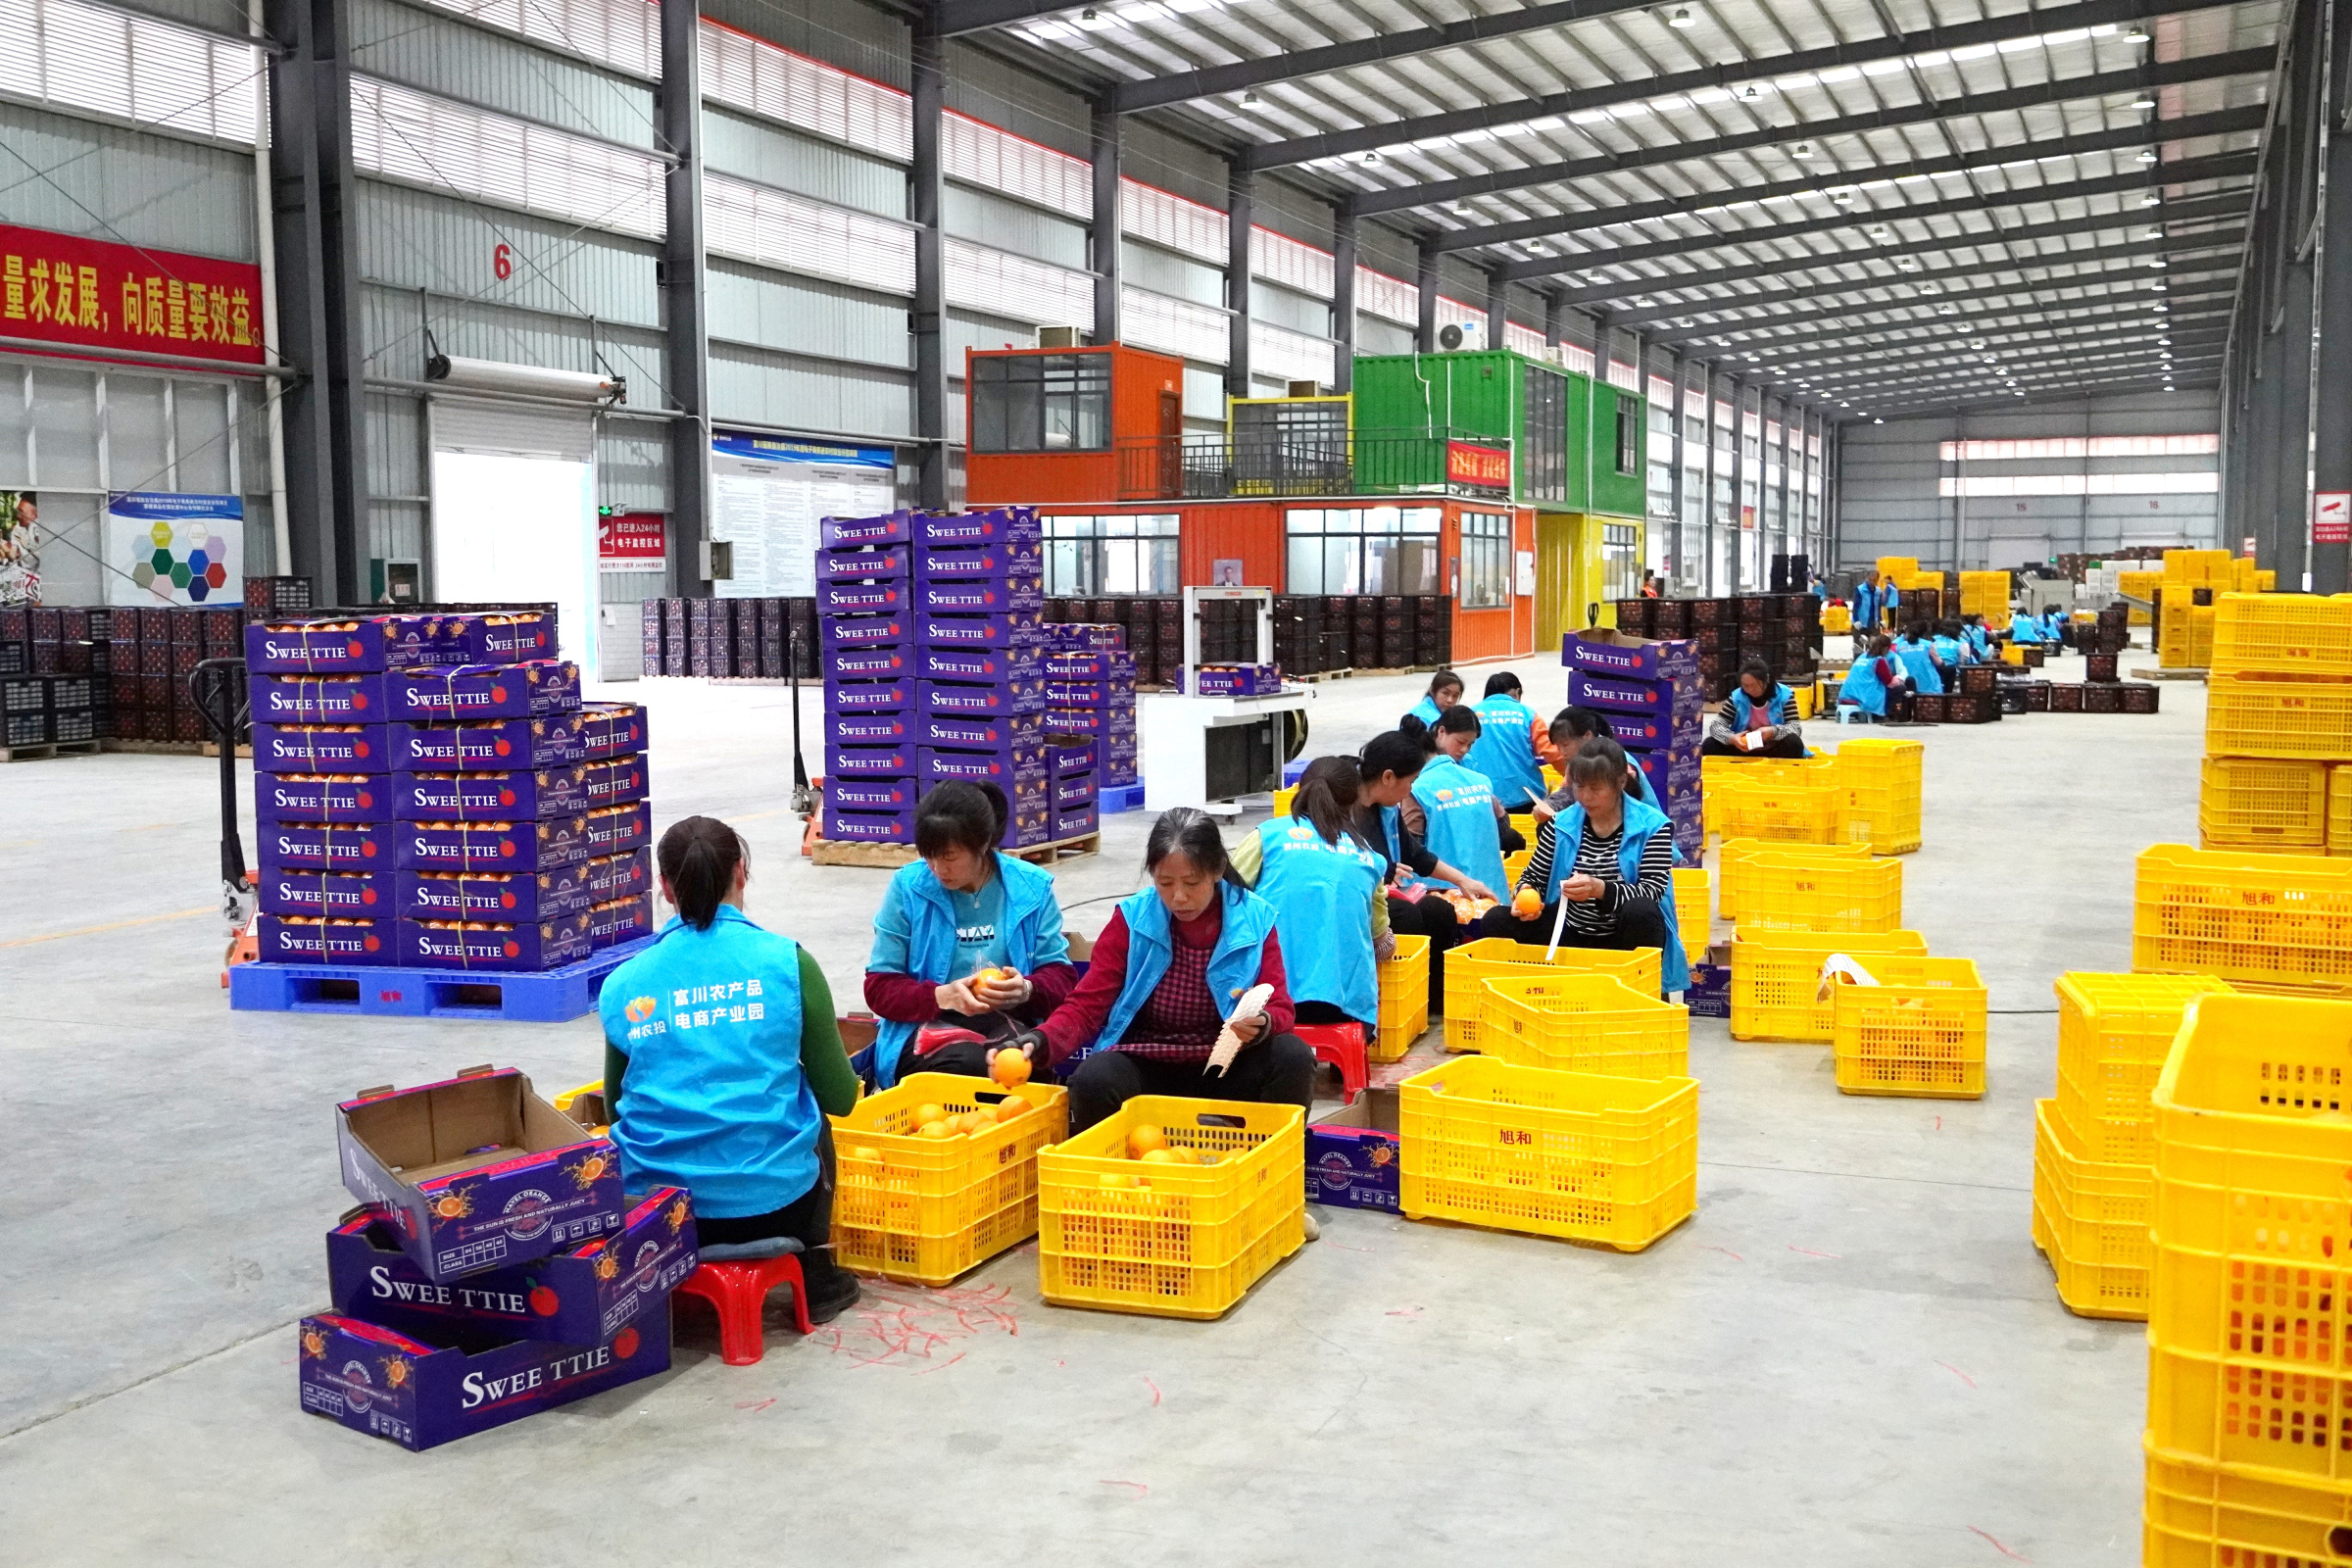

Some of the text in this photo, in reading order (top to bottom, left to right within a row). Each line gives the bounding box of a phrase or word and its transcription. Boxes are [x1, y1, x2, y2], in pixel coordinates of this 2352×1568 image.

[494, 244, 511, 281] 6
[616, 523, 661, 533] 您已进入24小时
[617, 538, 661, 548] 电子监控区域
[1796, 882, 1815, 891] 旭和
[2242, 892, 2275, 905] 旭和
[673, 979, 762, 1006] 富川农产品
[675, 1004, 764, 1029] 电商产业园
[1499, 1129, 1532, 1145] 旭和
[505, 1191, 552, 1213] NAVEL ORANGE
[506, 1215, 522, 1224] FRESH
[536, 1203, 568, 1215] NATURALLY
